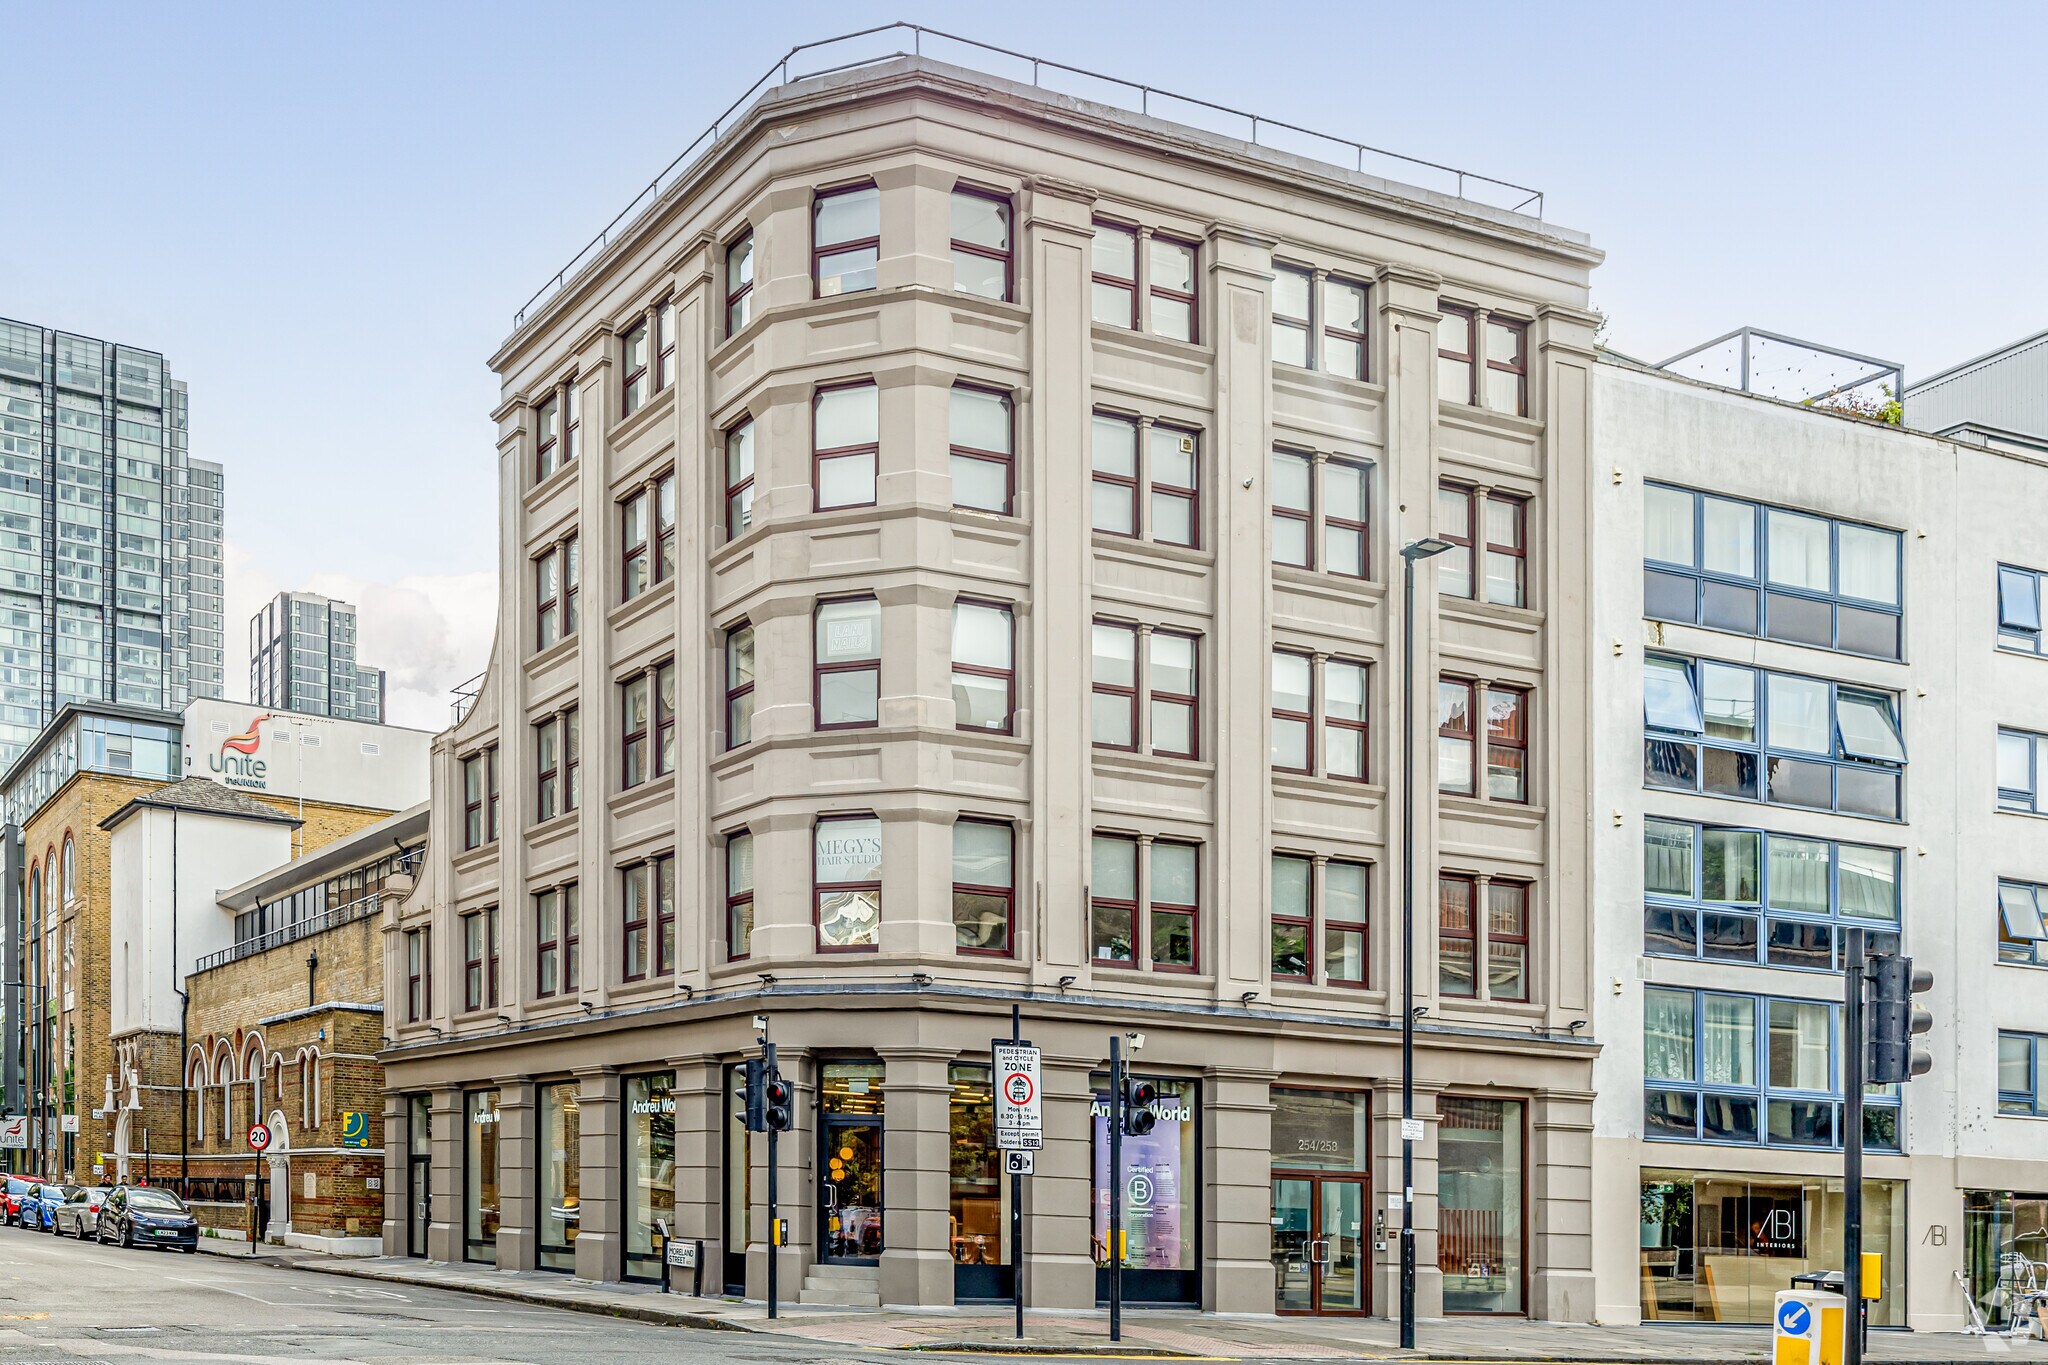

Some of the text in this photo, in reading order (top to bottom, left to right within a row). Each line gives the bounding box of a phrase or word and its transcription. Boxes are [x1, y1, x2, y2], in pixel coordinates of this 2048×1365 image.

[834, 623, 864, 638] LANI
[831, 636, 868, 651] NAILS
[817, 838, 881, 855] MEGY'S
[817, 854, 882, 866] HAIR STUDIO
[998, 1048, 1038, 1056] PEDESTRIAN
[1004, 1062, 1033, 1072] ZONE
[632, 1098, 676, 1114] Andreu Wo
[473, 1111, 493, 1124] Andreu
[1149, 1105, 1191, 1122] World
[251, 1131, 266, 1142] 20
[1298, 1139, 1338, 1152] 254/258
[1127, 1165, 1154, 1174] Certified
[1134, 1180, 1147, 1200] B
[1757, 1209, 1796, 1240] ABI
[1922, 1224, 1947, 1247] ABI
[669, 1247, 695, 1258] MORELAND
[668, 1255, 686, 1265] STREET
